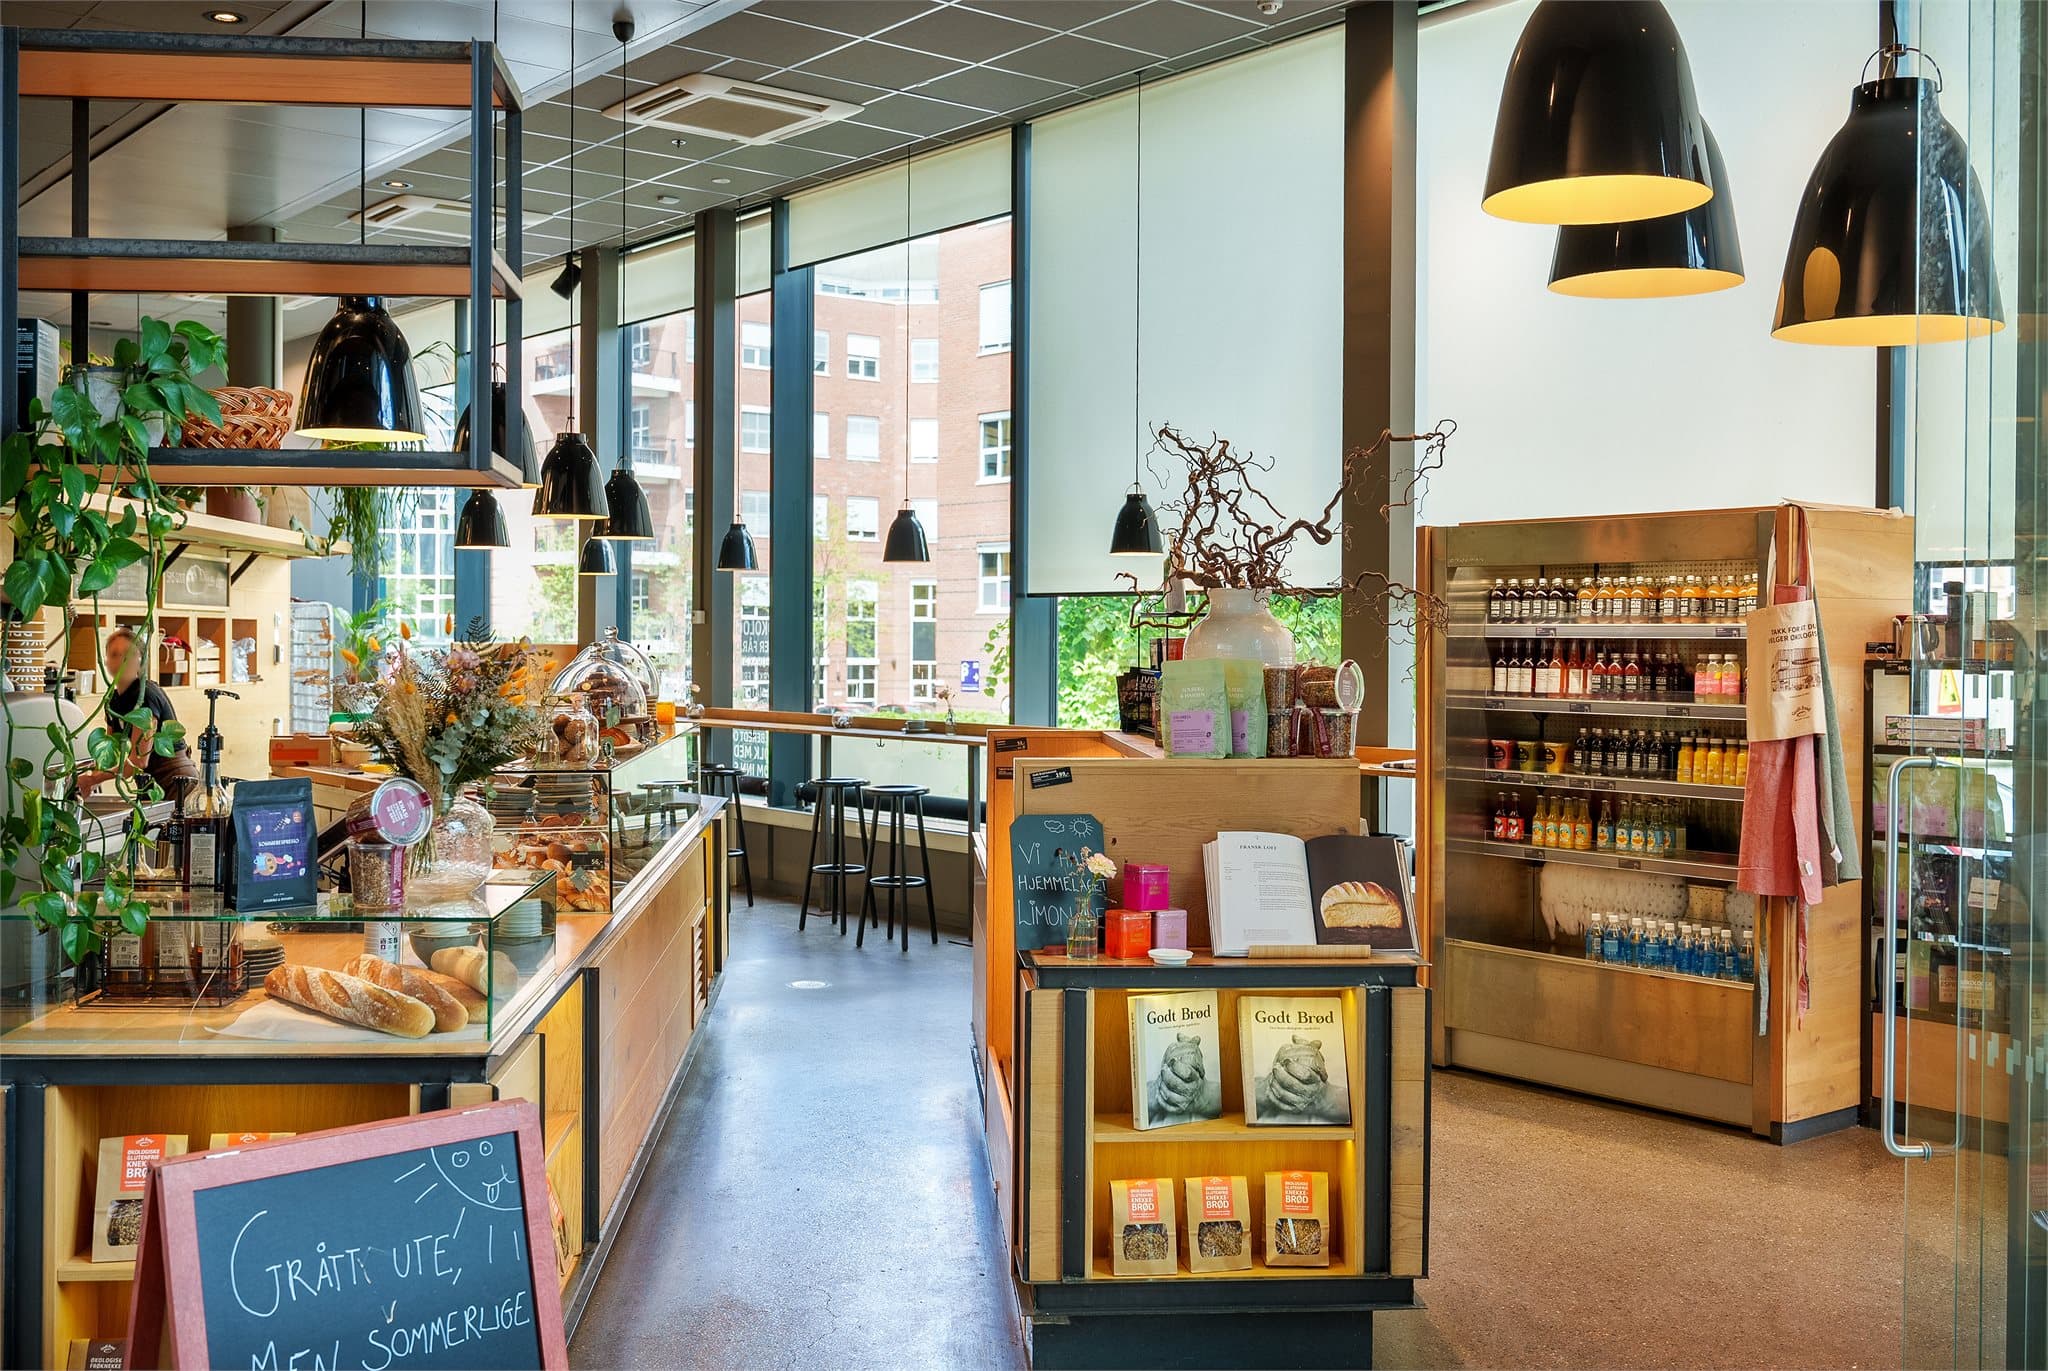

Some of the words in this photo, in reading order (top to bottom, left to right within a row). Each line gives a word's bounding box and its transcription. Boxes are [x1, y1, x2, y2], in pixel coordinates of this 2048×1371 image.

[1147, 1008, 1176, 1025] Godt
[1181, 1004, 1211, 1021] Brød
[1255, 1010, 1291, 1024] Godt
[1297, 1010, 1334, 1024] Brød
[1206, 1200, 1230, 1209] BRØD
[1286, 1195, 1310, 1204] BRØD
[1131, 1203, 1155, 1212] BRØD
[362, 1291, 530, 1371] SOMMERLIGE
